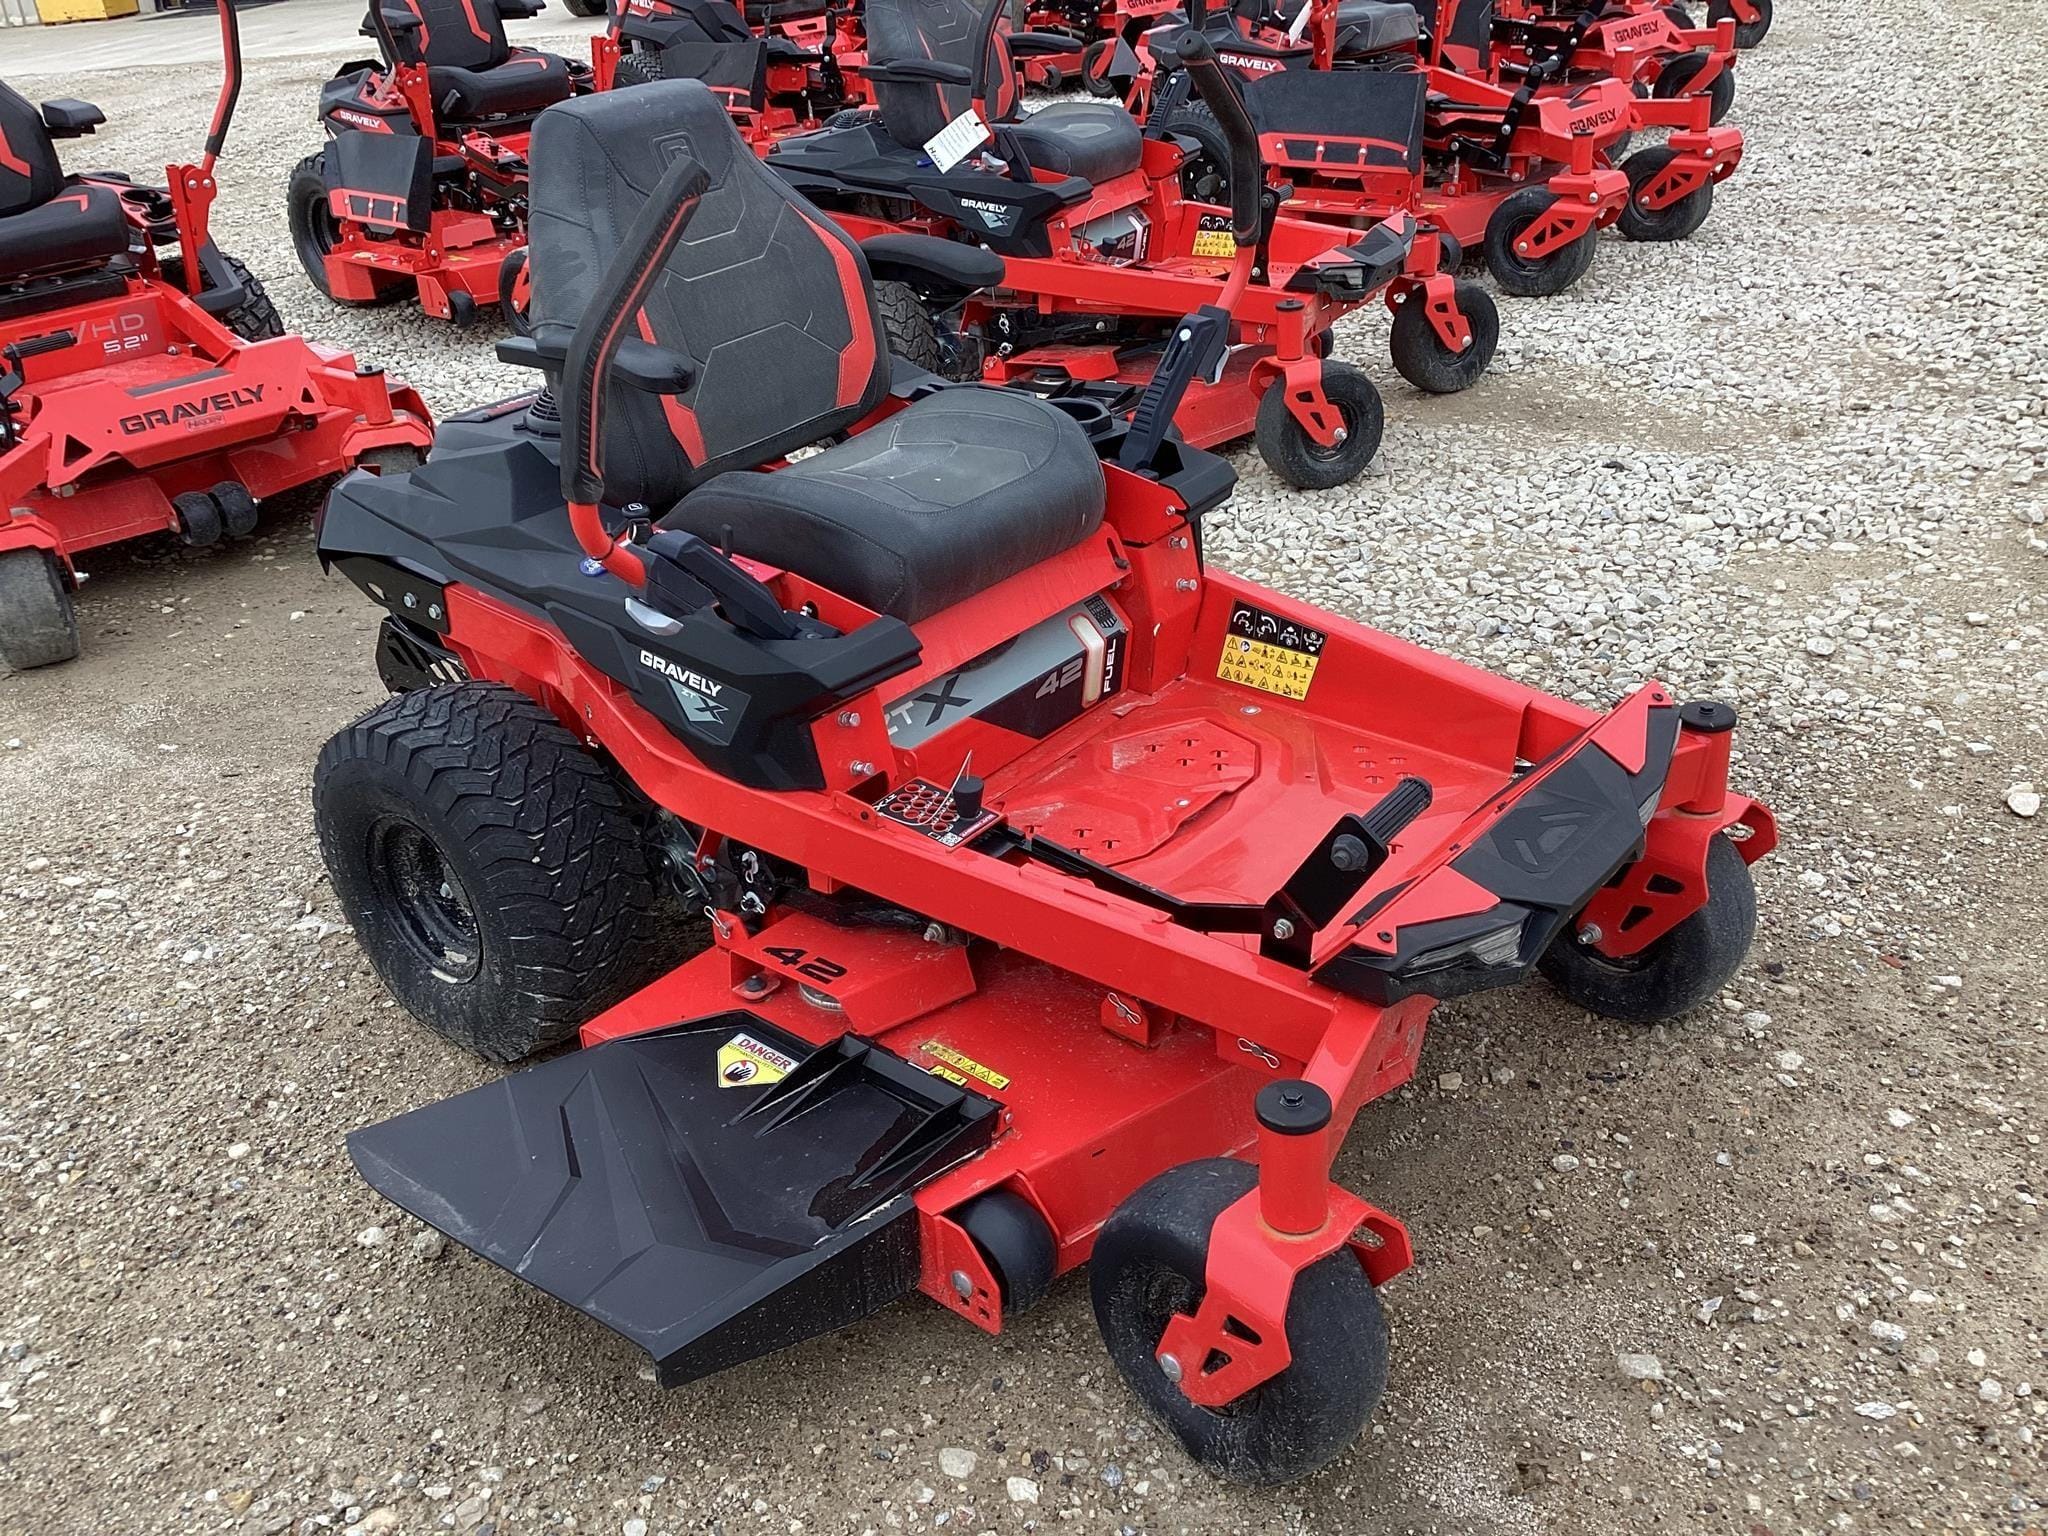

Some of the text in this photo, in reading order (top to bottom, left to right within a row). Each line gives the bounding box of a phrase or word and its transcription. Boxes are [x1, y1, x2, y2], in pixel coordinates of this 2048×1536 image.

[1614, 20, 1659, 42] GRAVELY
[1219, 54, 1277, 71] GRAVELY
[340, 110, 380, 128] GRAVELY
[961, 198, 1007, 213] GRAVELY
[1117, 233, 1135, 250] 42
[119, 383, 264, 436] GRAVELY
[640, 650, 722, 697] GRAVELY
[1035, 657, 1083, 700] 42
[1103, 638, 1116, 693] FUEL
[761, 946, 848, 985] 42
[737, 1038, 792, 1070] DANGER
